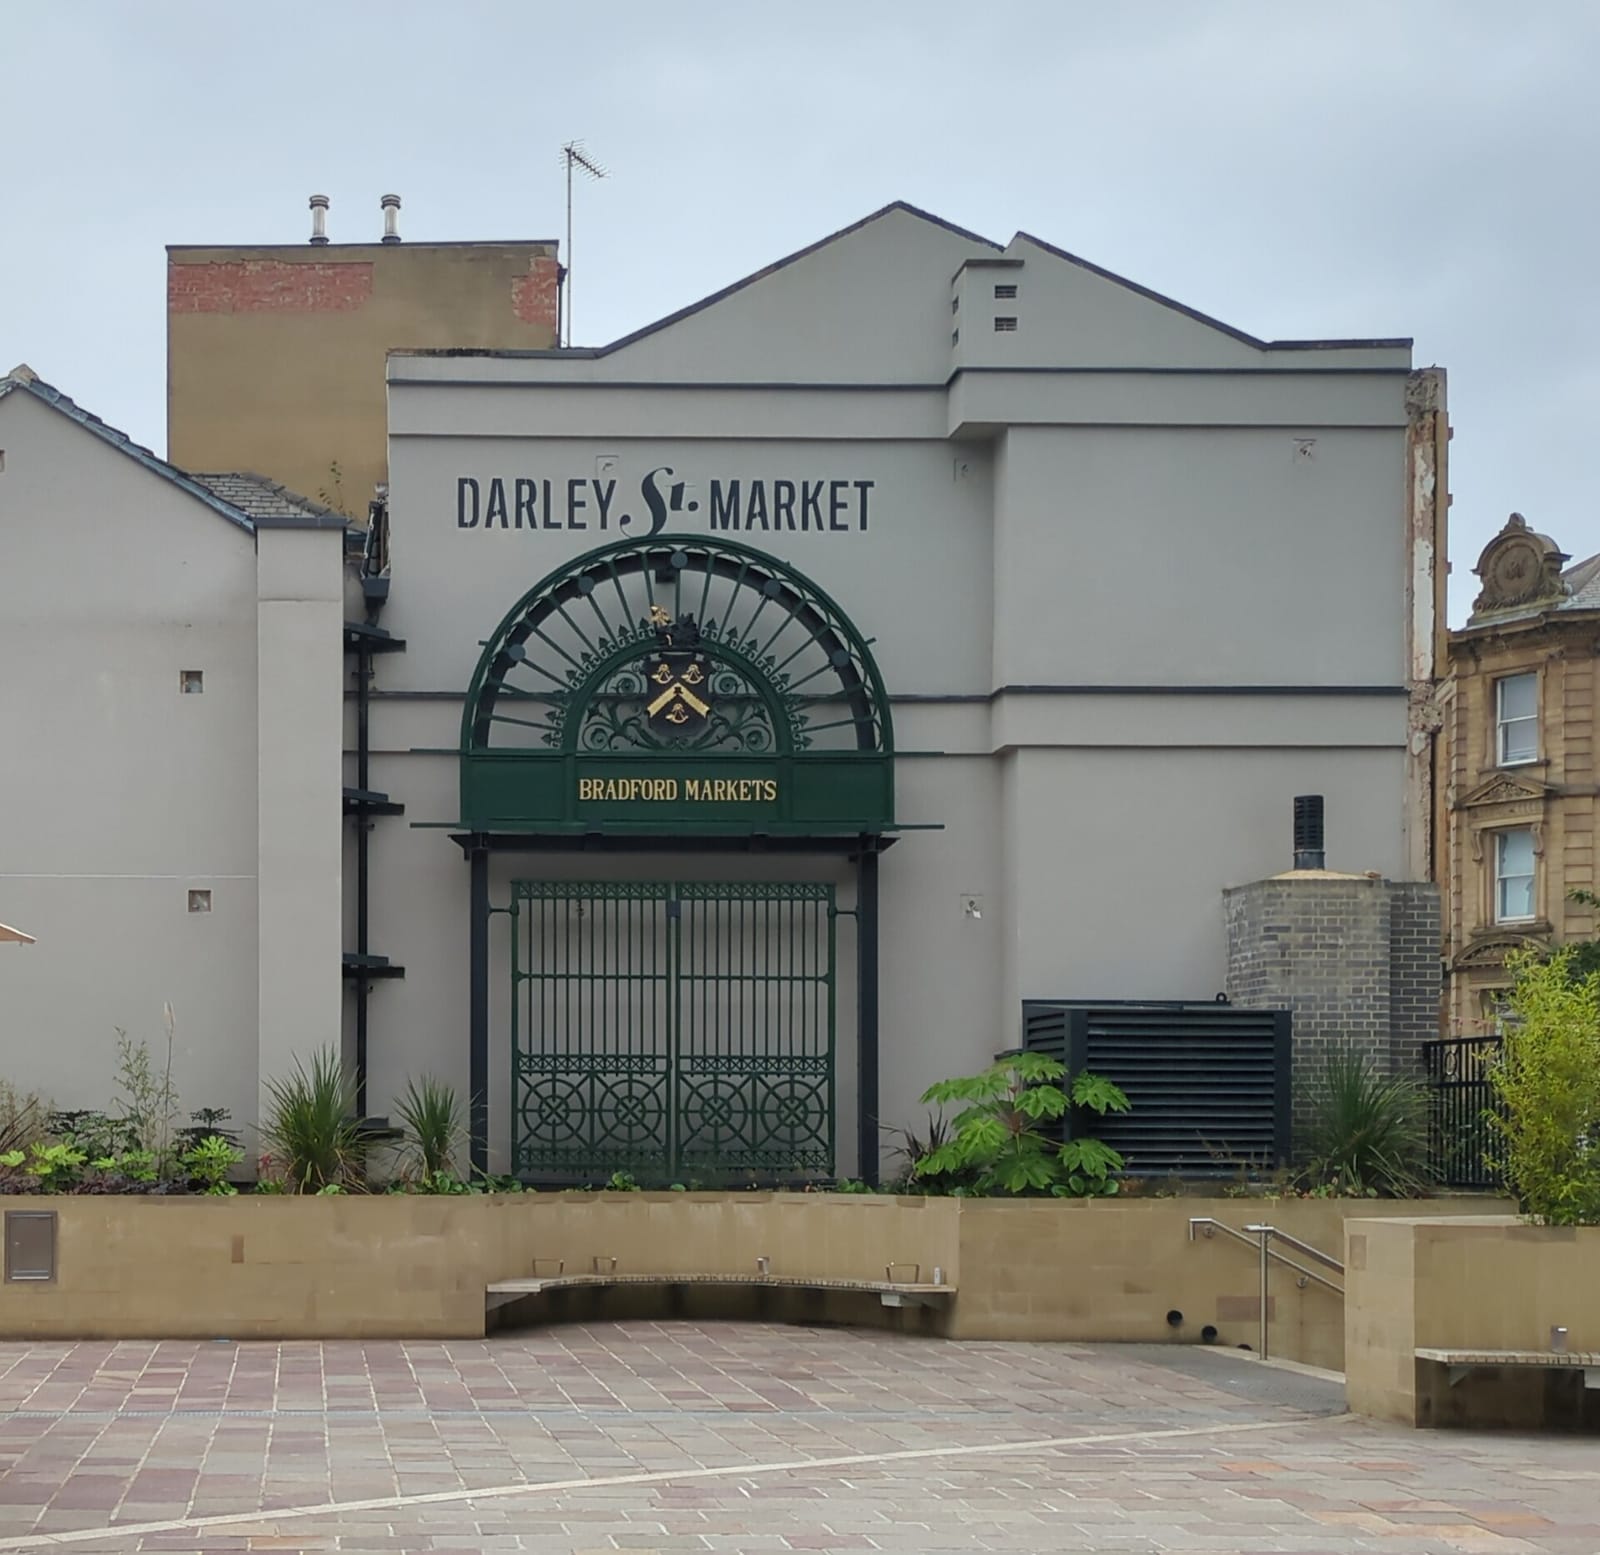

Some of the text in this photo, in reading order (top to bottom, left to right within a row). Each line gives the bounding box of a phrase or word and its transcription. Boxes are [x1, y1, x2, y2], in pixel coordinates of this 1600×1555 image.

[457, 466, 875, 539] DARLEY St. MARKET
[578, 778, 777, 801] BRADFORD MARKETS
